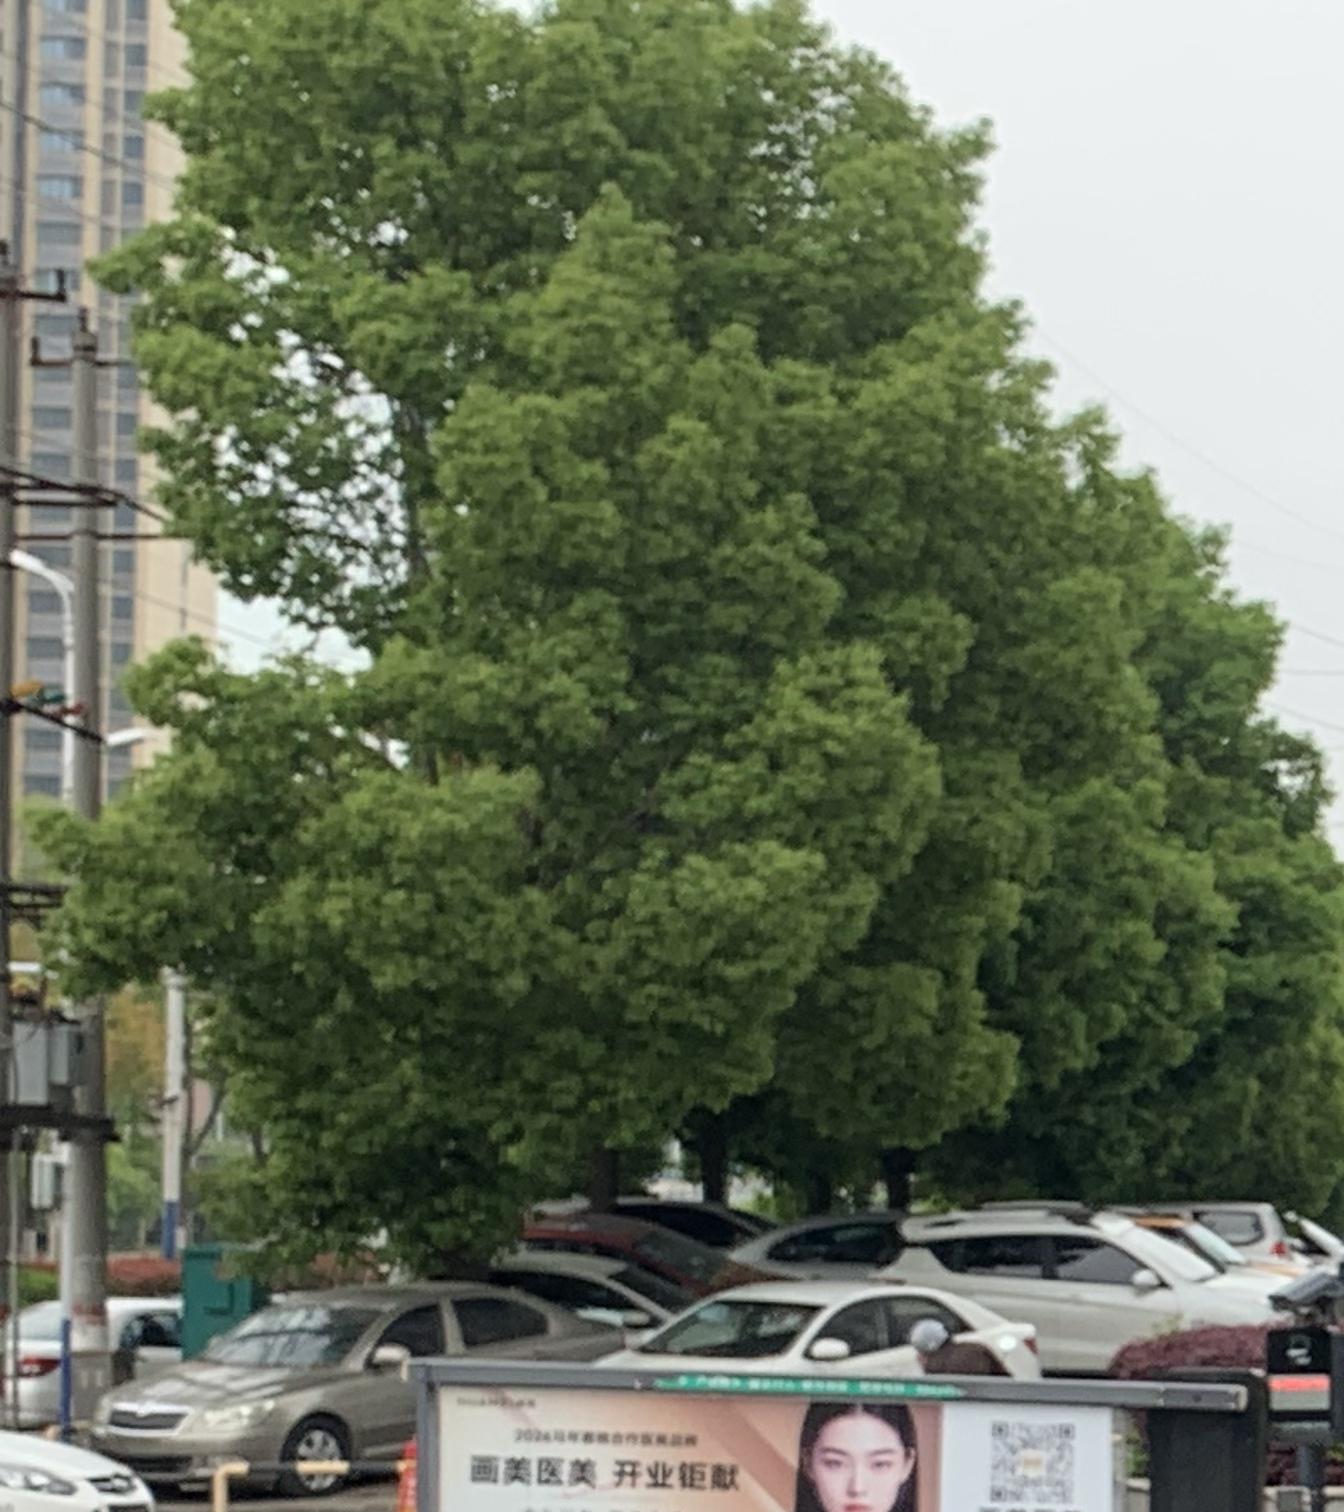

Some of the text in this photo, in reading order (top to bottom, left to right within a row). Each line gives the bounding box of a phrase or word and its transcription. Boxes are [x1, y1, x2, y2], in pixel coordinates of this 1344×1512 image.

[469, 1455, 740, 1491] 画美医美 开业钜献
